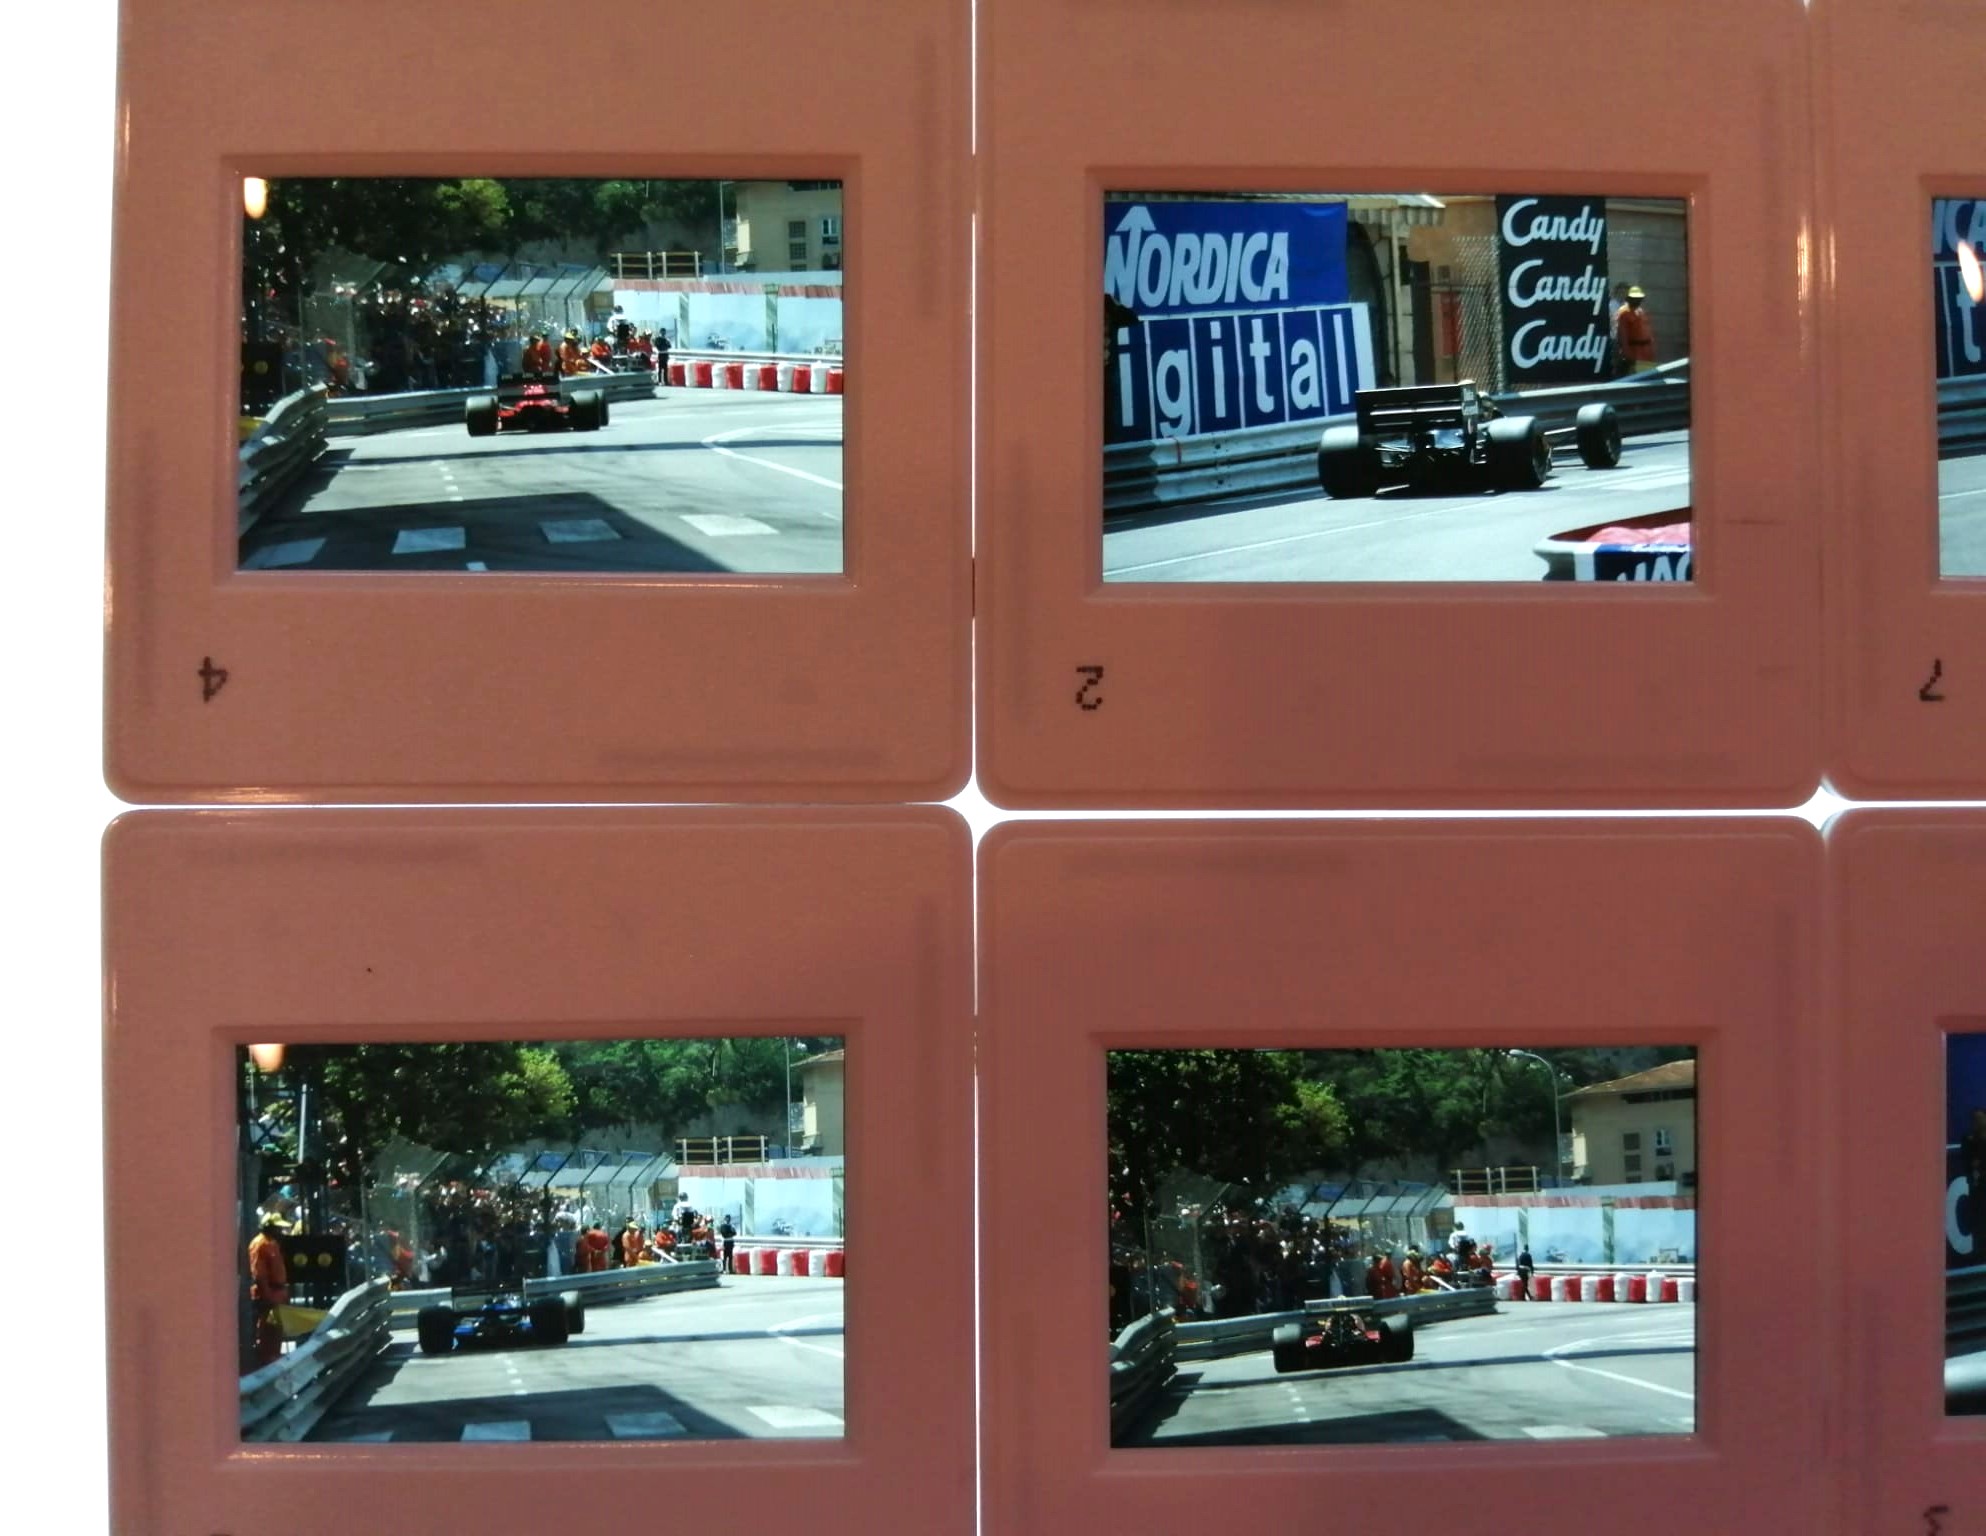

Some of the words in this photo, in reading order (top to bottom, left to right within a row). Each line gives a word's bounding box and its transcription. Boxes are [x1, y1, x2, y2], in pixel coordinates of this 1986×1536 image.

[1502, 198, 1604, 255] Candy
[1104, 229, 1289, 308] NORDICA
[1508, 259, 1607, 316] Candy
[1511, 319, 1608, 374] Candy
[198, 655, 227, 704] 4
[1076, 665, 1104, 711] 2
